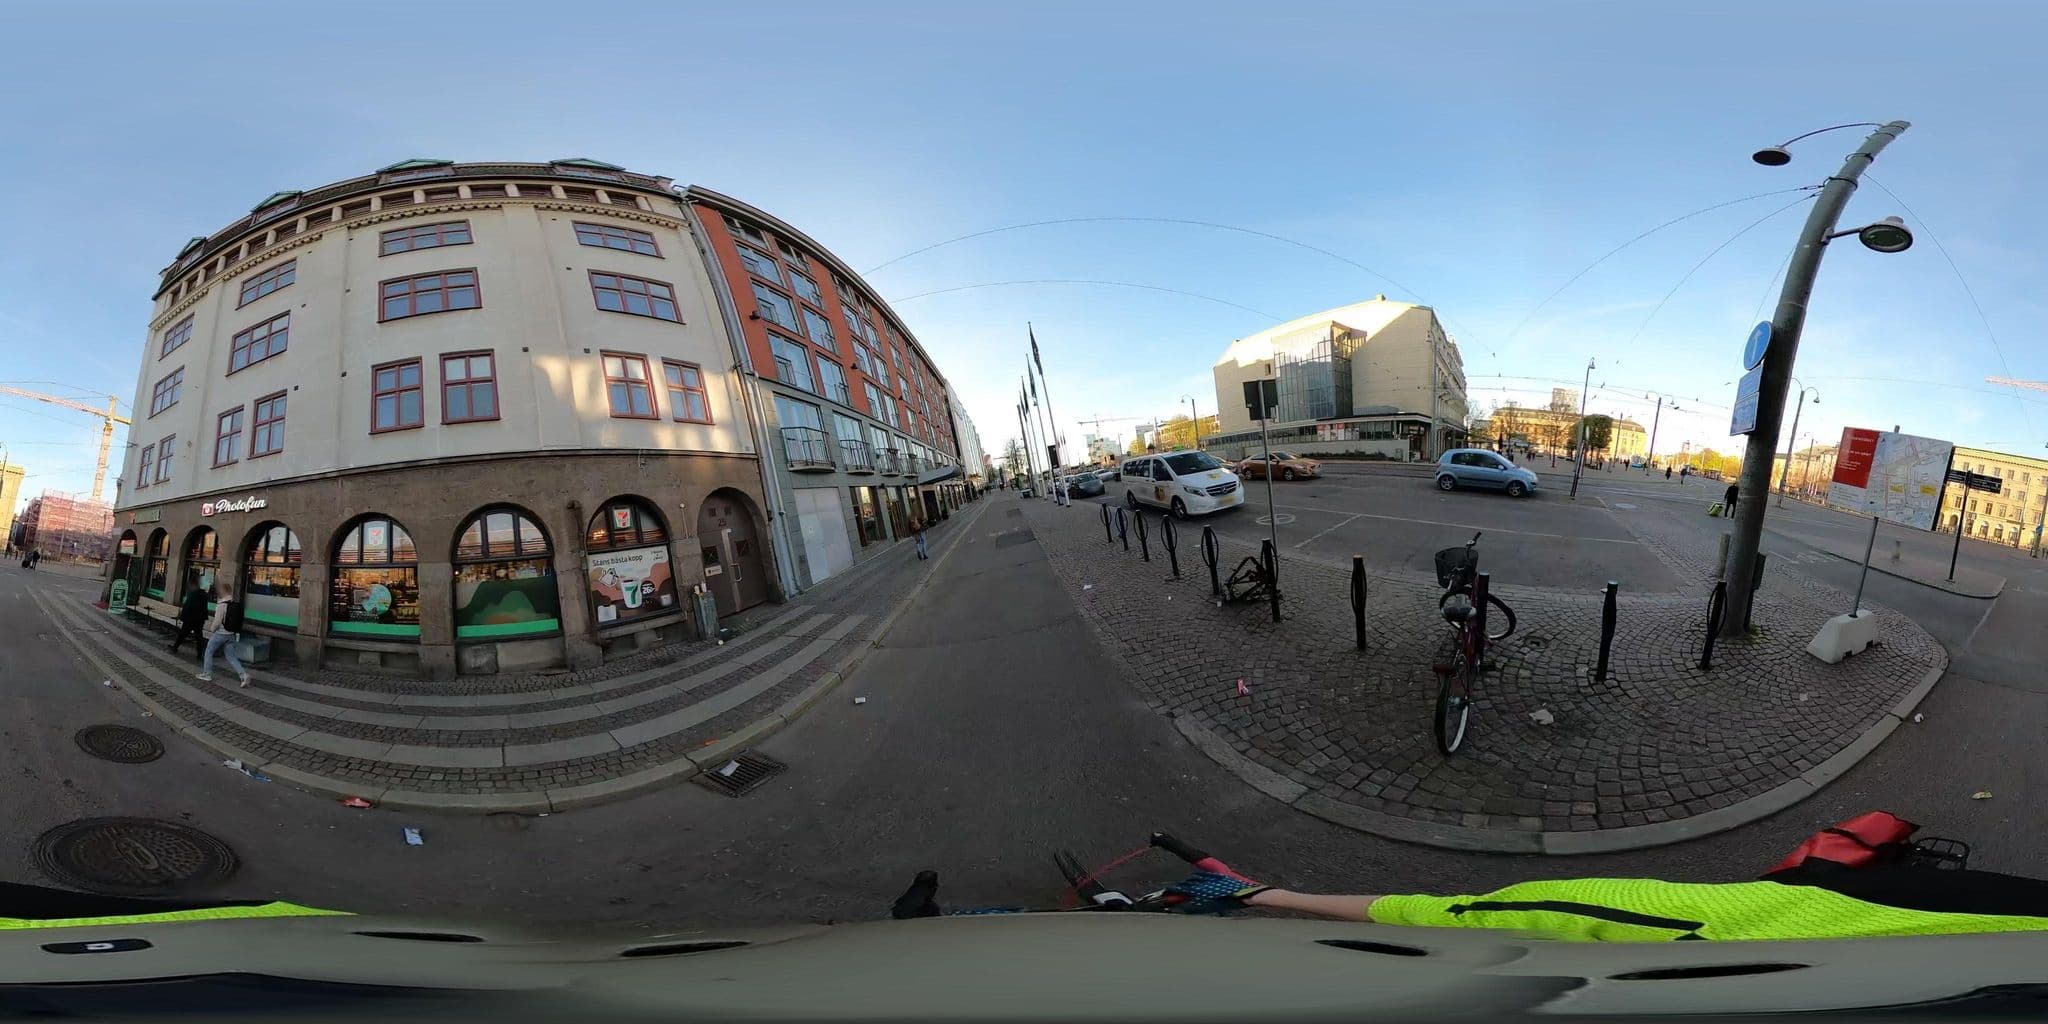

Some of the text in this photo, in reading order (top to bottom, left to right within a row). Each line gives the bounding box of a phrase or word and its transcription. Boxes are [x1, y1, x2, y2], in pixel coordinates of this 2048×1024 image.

[216, 496, 266, 513] Photofun
[592, 558, 610, 567] Stans
[628, 554, 643, 563] kopp
